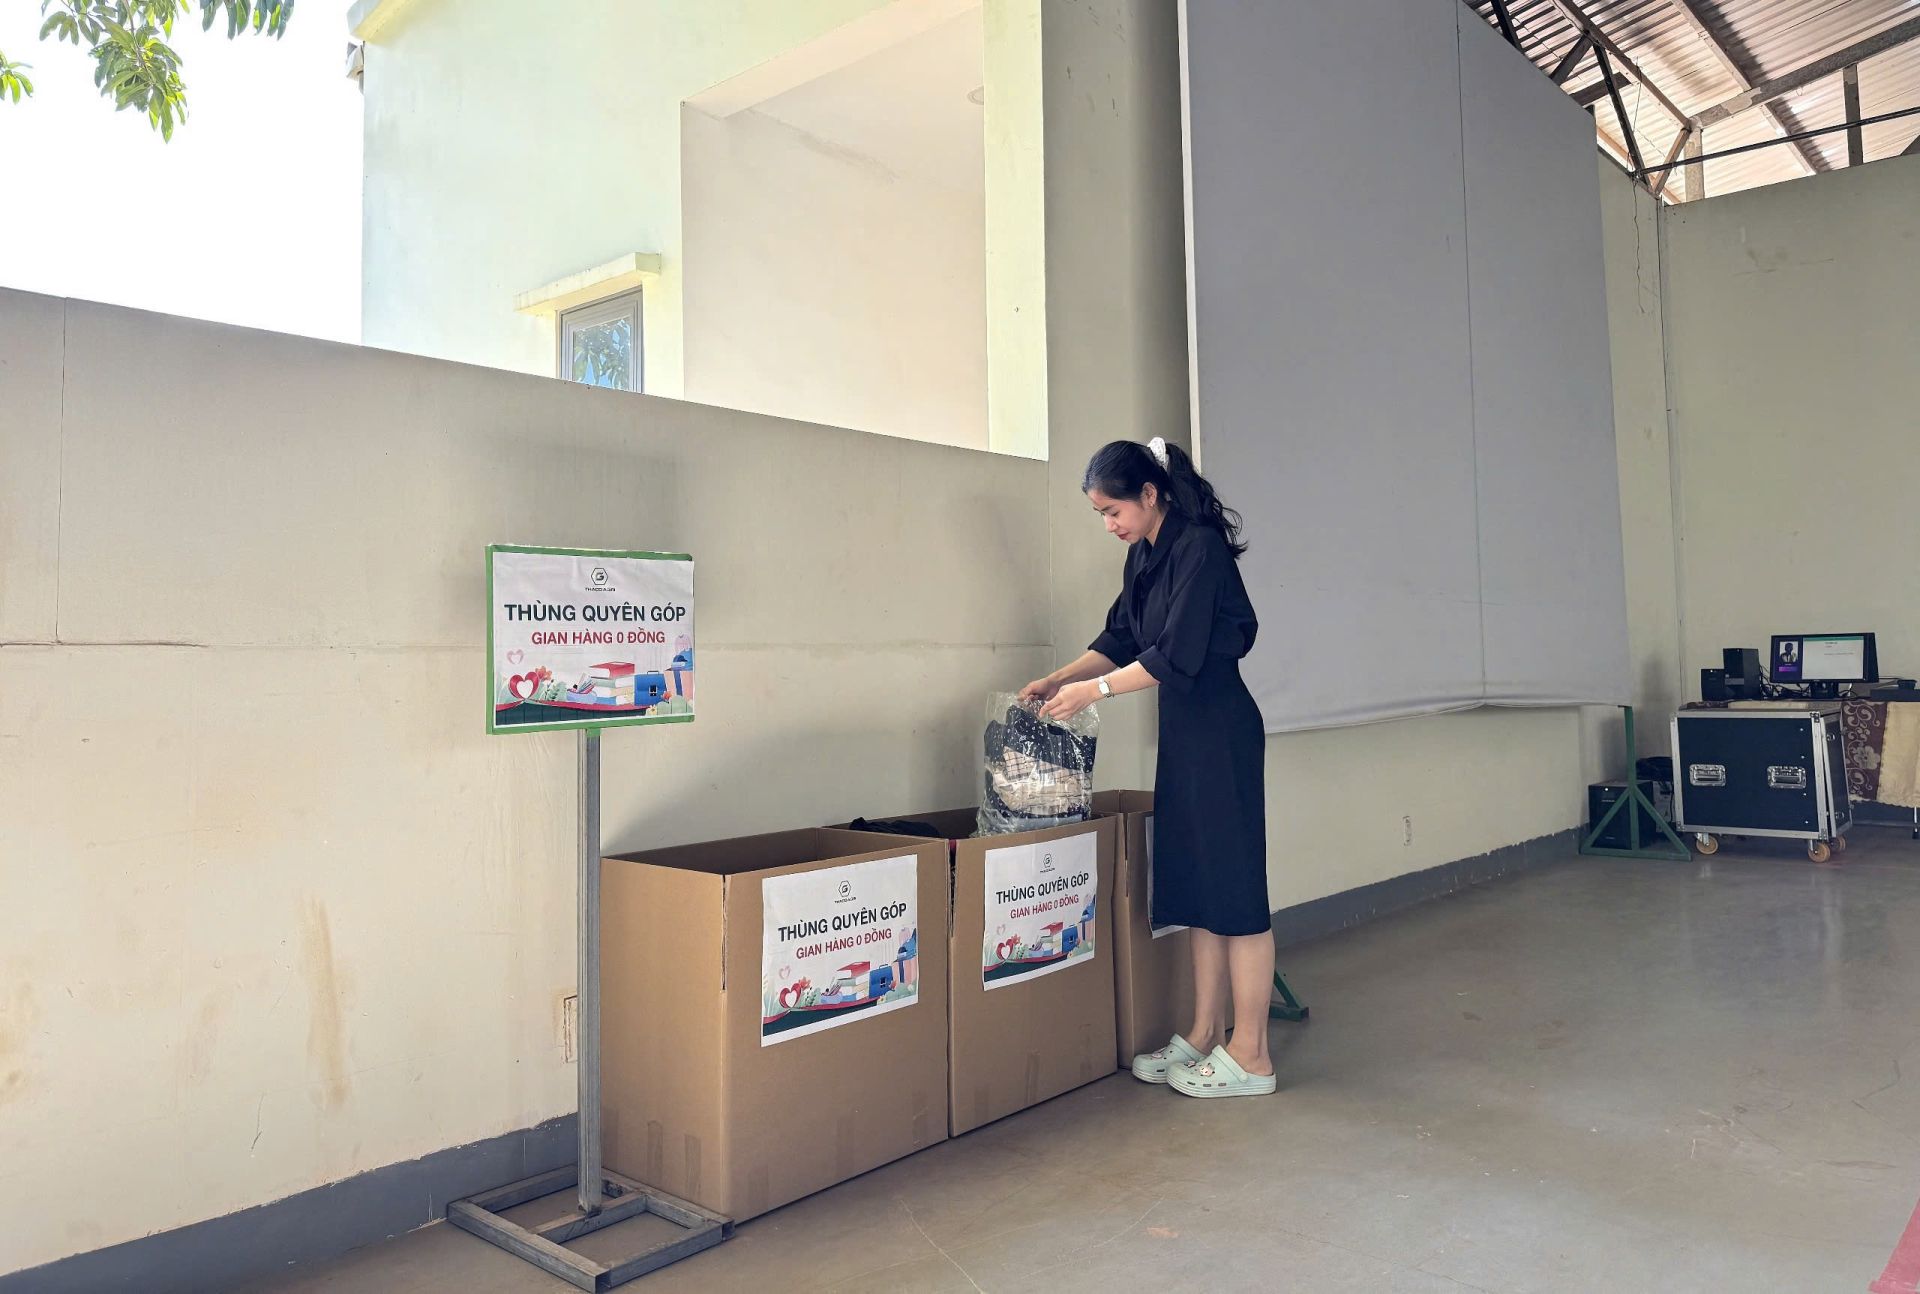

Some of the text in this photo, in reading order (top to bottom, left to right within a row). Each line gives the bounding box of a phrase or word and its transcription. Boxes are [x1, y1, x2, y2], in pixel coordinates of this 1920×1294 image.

[504, 600, 686, 623] THÙNG QUYÊN GÓP
[531, 627, 666, 645] GIAN HÀNG 0 ĐỒNG
[996, 871, 1089, 905] THÙNG QUYÊN GÓP
[1010, 906, 1030, 919] GIAN
[1032, 900, 1053, 916] HÀNG
[1059, 893, 1079, 908] ĐỒNG
[778, 901, 907, 943] THÙNG QUYÊN GÓP
[796, 943, 822, 960] GIAN
[825, 937, 854, 954] HÀNG
[864, 927, 892, 945] ĐỒNG
